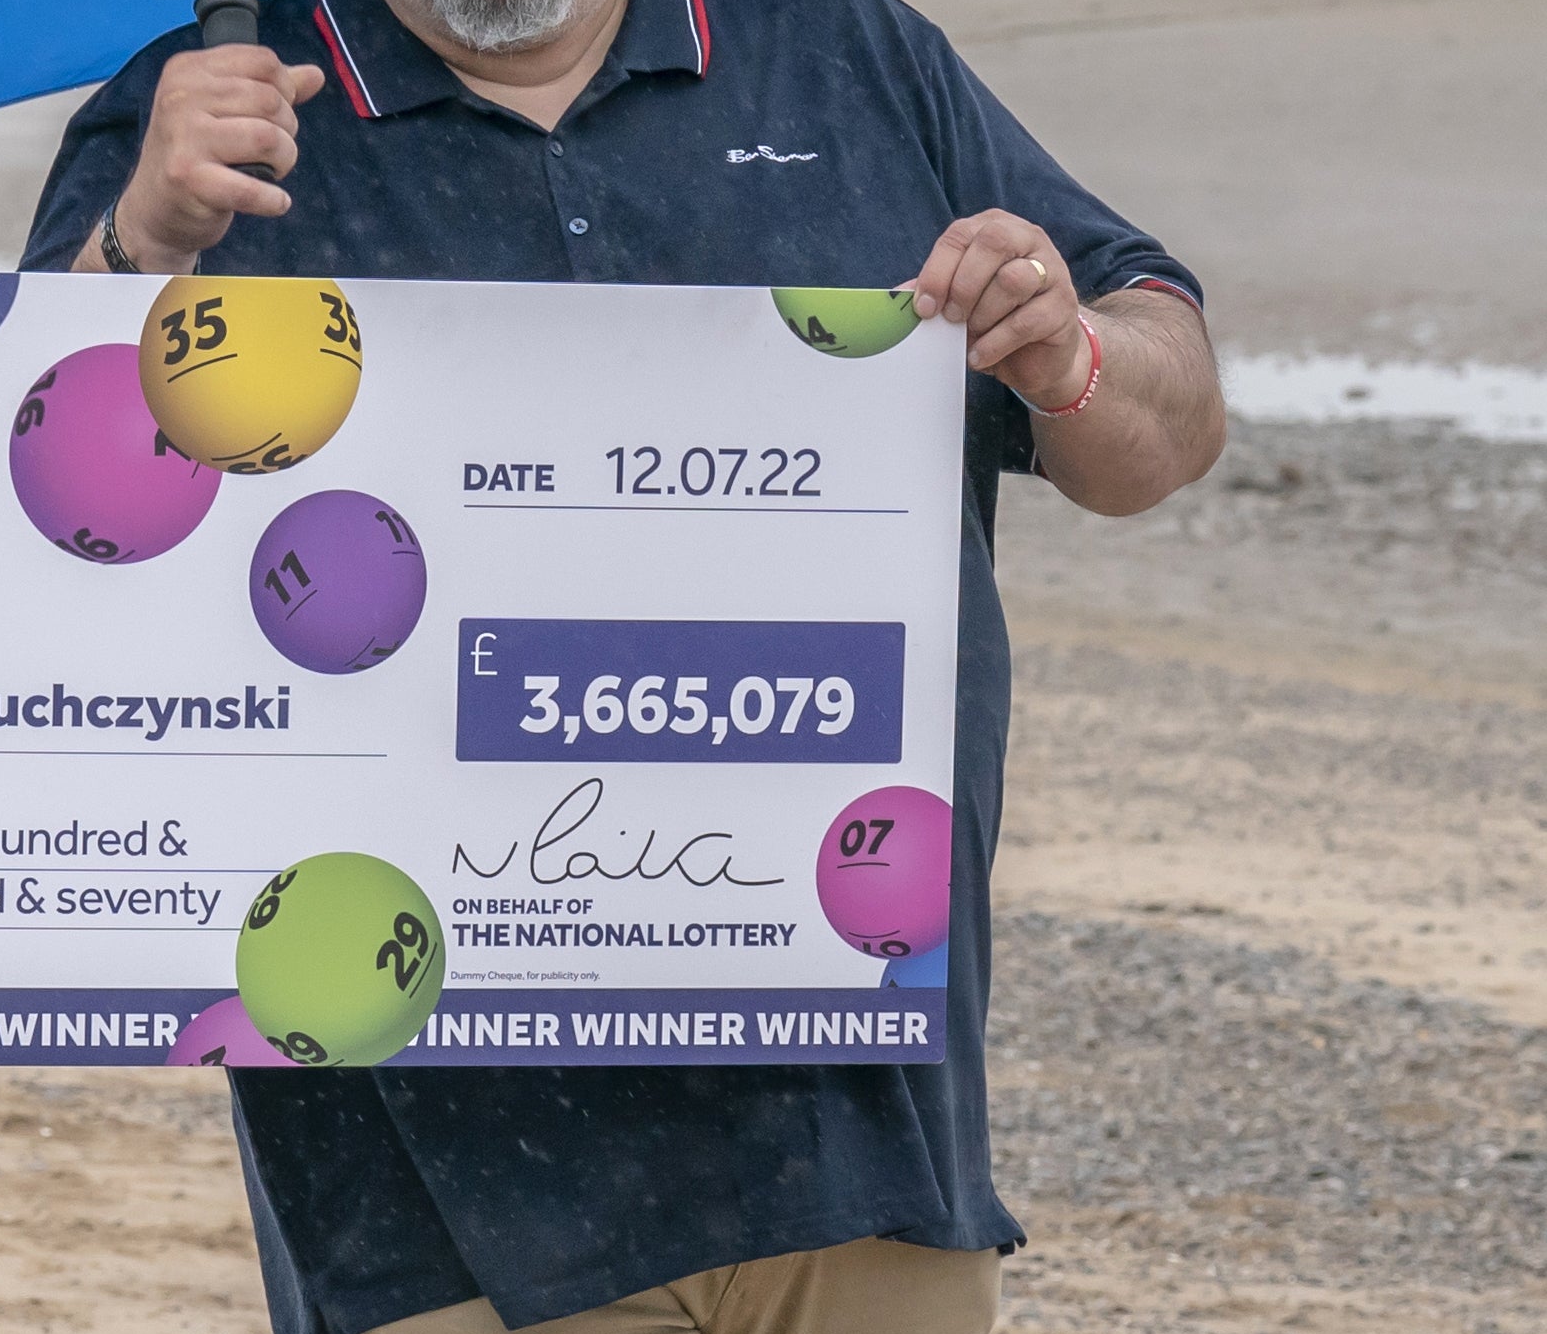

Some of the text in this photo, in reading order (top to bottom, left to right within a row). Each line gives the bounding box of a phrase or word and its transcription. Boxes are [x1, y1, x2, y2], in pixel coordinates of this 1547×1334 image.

[161, 296, 228, 365] 35
[463, 446, 821, 497] DATE 12.07.22
[263, 549, 312, 606] 11
[470, 632, 855, 745] £ 3,665,079
[158, 819, 188, 857] &
[840, 819, 896, 857] 07
[16, 877, 46, 915] &
[56, 881, 222, 926] seventy
[452, 898, 594, 915] ON BEHALF OF
[375, 911, 430, 992] 29
[452, 923, 797, 947] THE NATIONAL LOTTERY
[450, 970, 601, 983] Dummy Cheque, for publicity only.
[408, 1013, 561, 1047] INNER
[568, 1013, 748, 1046] WINNER
[755, 1012, 929, 1046] WINNER
